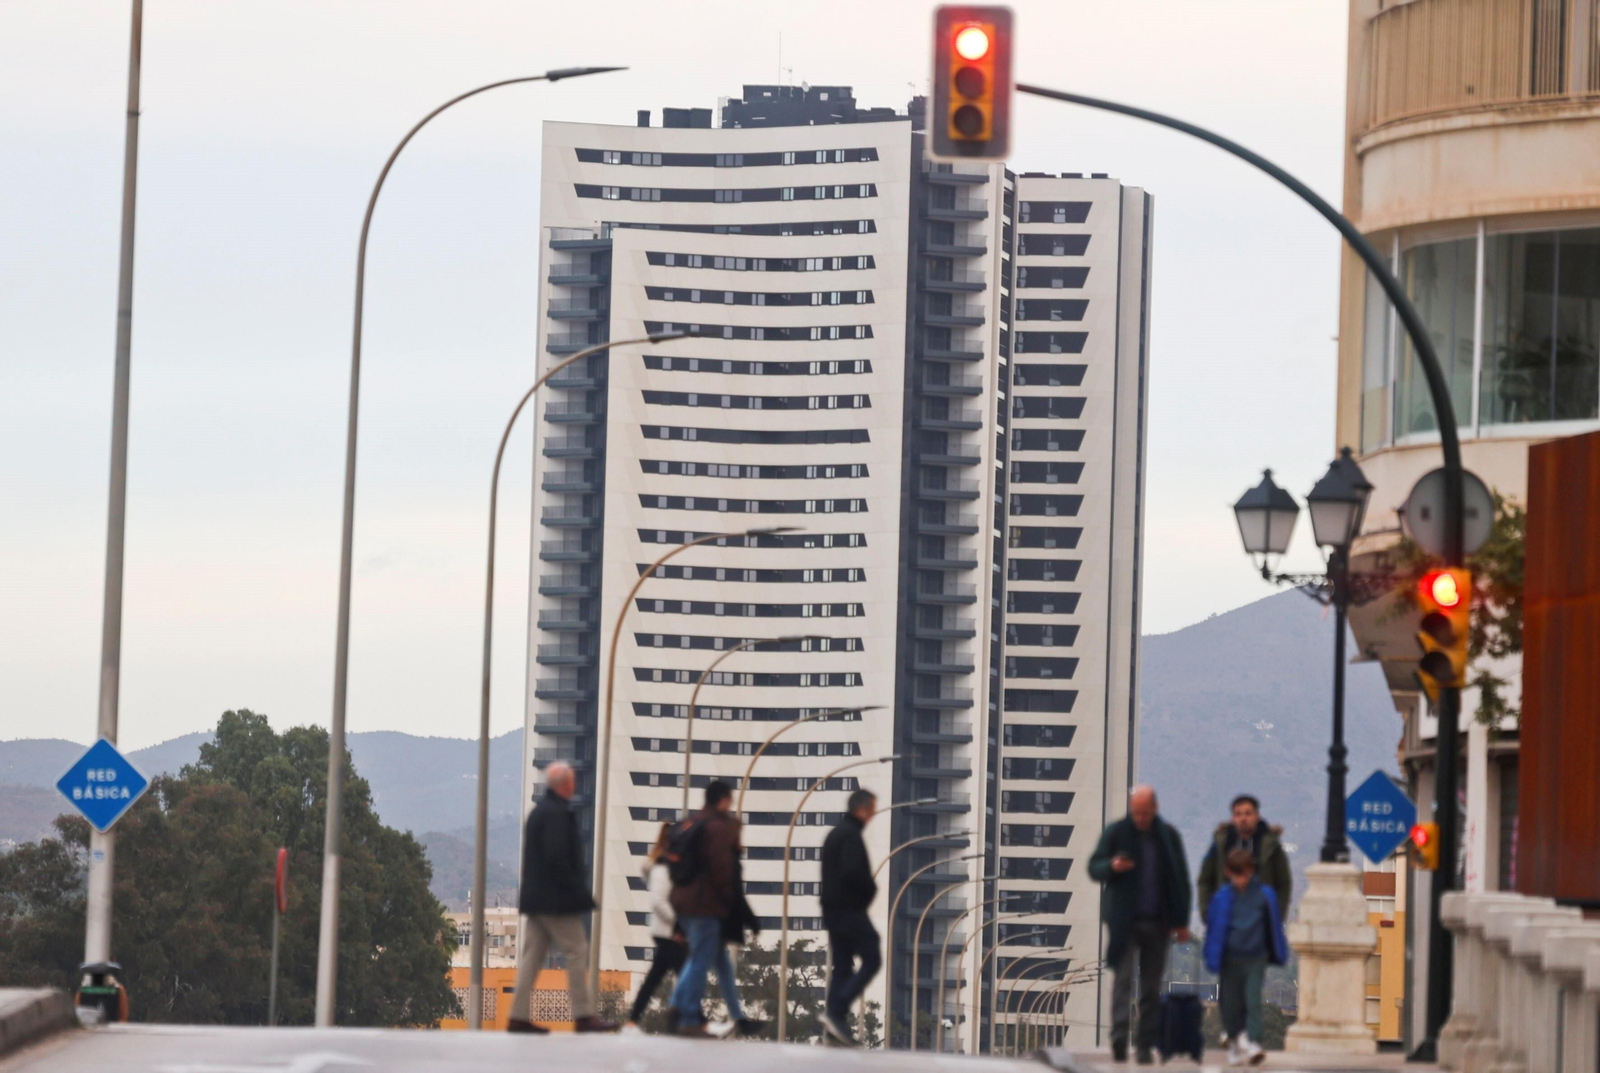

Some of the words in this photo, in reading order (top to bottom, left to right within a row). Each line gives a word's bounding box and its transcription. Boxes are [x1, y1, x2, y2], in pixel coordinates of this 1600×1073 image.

[87, 769, 116, 782] RED
[73, 785, 130, 800] BÁSICA
[1363, 802, 1393, 815] RED
[1348, 818, 1406, 833] BÁSICA
